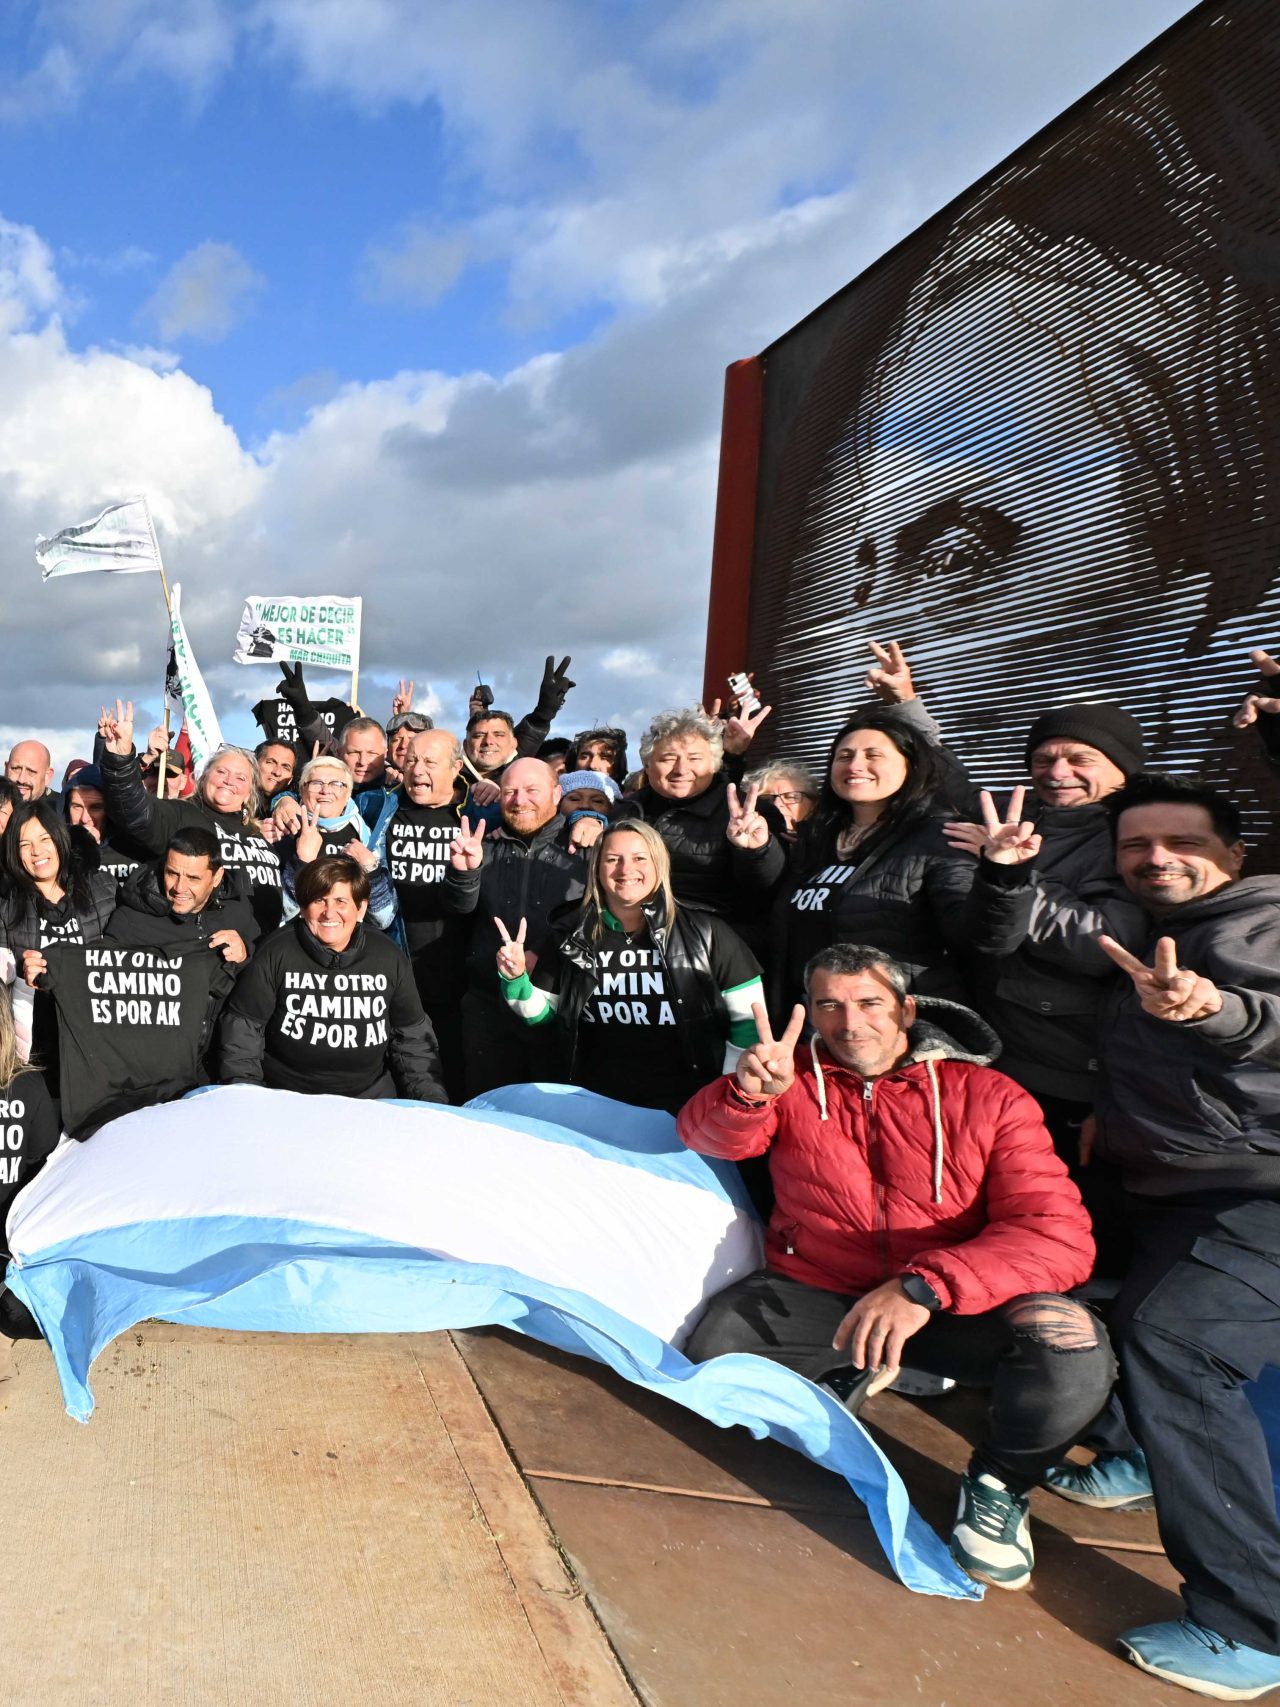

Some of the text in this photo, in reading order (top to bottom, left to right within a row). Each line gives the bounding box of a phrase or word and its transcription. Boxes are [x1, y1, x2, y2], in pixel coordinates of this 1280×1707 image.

[301, 606, 316, 623] DE
[320, 606, 355, 624] DECIR
[278, 628, 293, 644] ES
[290, 649, 352, 665] MAR CHIQUITA
[278, 703, 293, 712] HA
[392, 823, 462, 840] HAY OTR
[220, 842, 280, 867] CAMINO
[391, 839, 451, 861] CAMI
[246, 865, 276, 886] POR
[391, 860, 446, 883] ES POR
[85, 949, 128, 967] HAY
[619, 949, 662, 967] OT
[87, 971, 181, 997] CAMINO
[285, 971, 388, 992] HAY OTRO
[91, 998, 181, 1026] ES POR AK
[285, 993, 387, 1020] CAMINO
[597, 1001, 652, 1026] POR
[658, 1000, 677, 1026] A
[280, 1011, 388, 1049] ES POR AK
